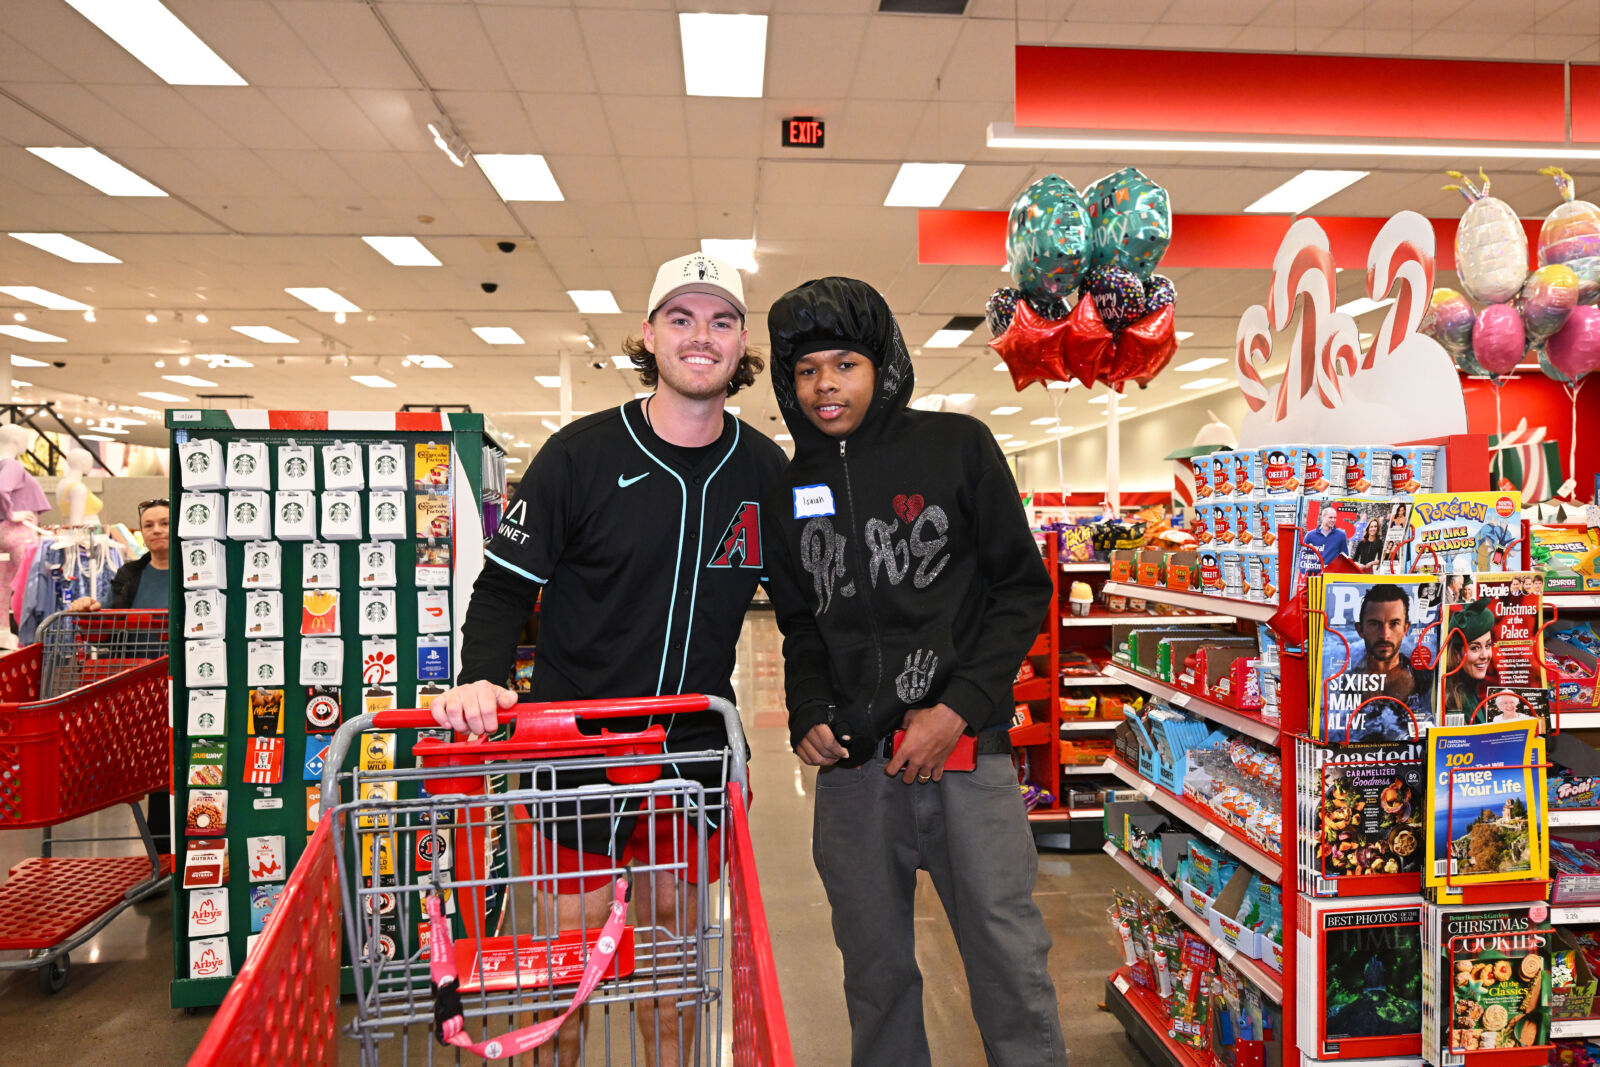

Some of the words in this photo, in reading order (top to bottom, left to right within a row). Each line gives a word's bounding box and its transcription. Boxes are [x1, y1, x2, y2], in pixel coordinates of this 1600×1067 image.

[790, 121, 819, 143] EXIT
[803, 496, 824, 506] Isaiah
[1422, 529, 1441, 542] FLY
[1442, 526, 1468, 540] LIKE
[1548, 579, 1576, 588] JOYRIDE
[1479, 584, 1510, 600] People
[1496, 602, 1537, 616] Christmas
[1514, 616, 1523, 624] the
[1501, 624, 1528, 640] Palace
[1330, 674, 1386, 692] SEXIEST
[1330, 694, 1362, 710] MAN
[1328, 713, 1366, 730] ALIVE
[1315, 744, 1423, 769] Roasted!
[1446, 752, 1474, 766] 100
[1346, 768, 1396, 778] CARAMELIZED
[1352, 776, 1391, 786] Goodness
[1459, 784, 1492, 797] Your
[1493, 779, 1522, 794] Life
[1558, 778, 1592, 798] Trolli
[192, 908, 222, 920] Arby's
[1328, 916, 1354, 926] BEST
[1356, 912, 1398, 924] PHOTOS
[1448, 918, 1529, 934] CHRISTMAS
[1448, 932, 1546, 953] COOKIES
[193, 958, 223, 970] Arby's
[1488, 987, 1529, 997] Classics
